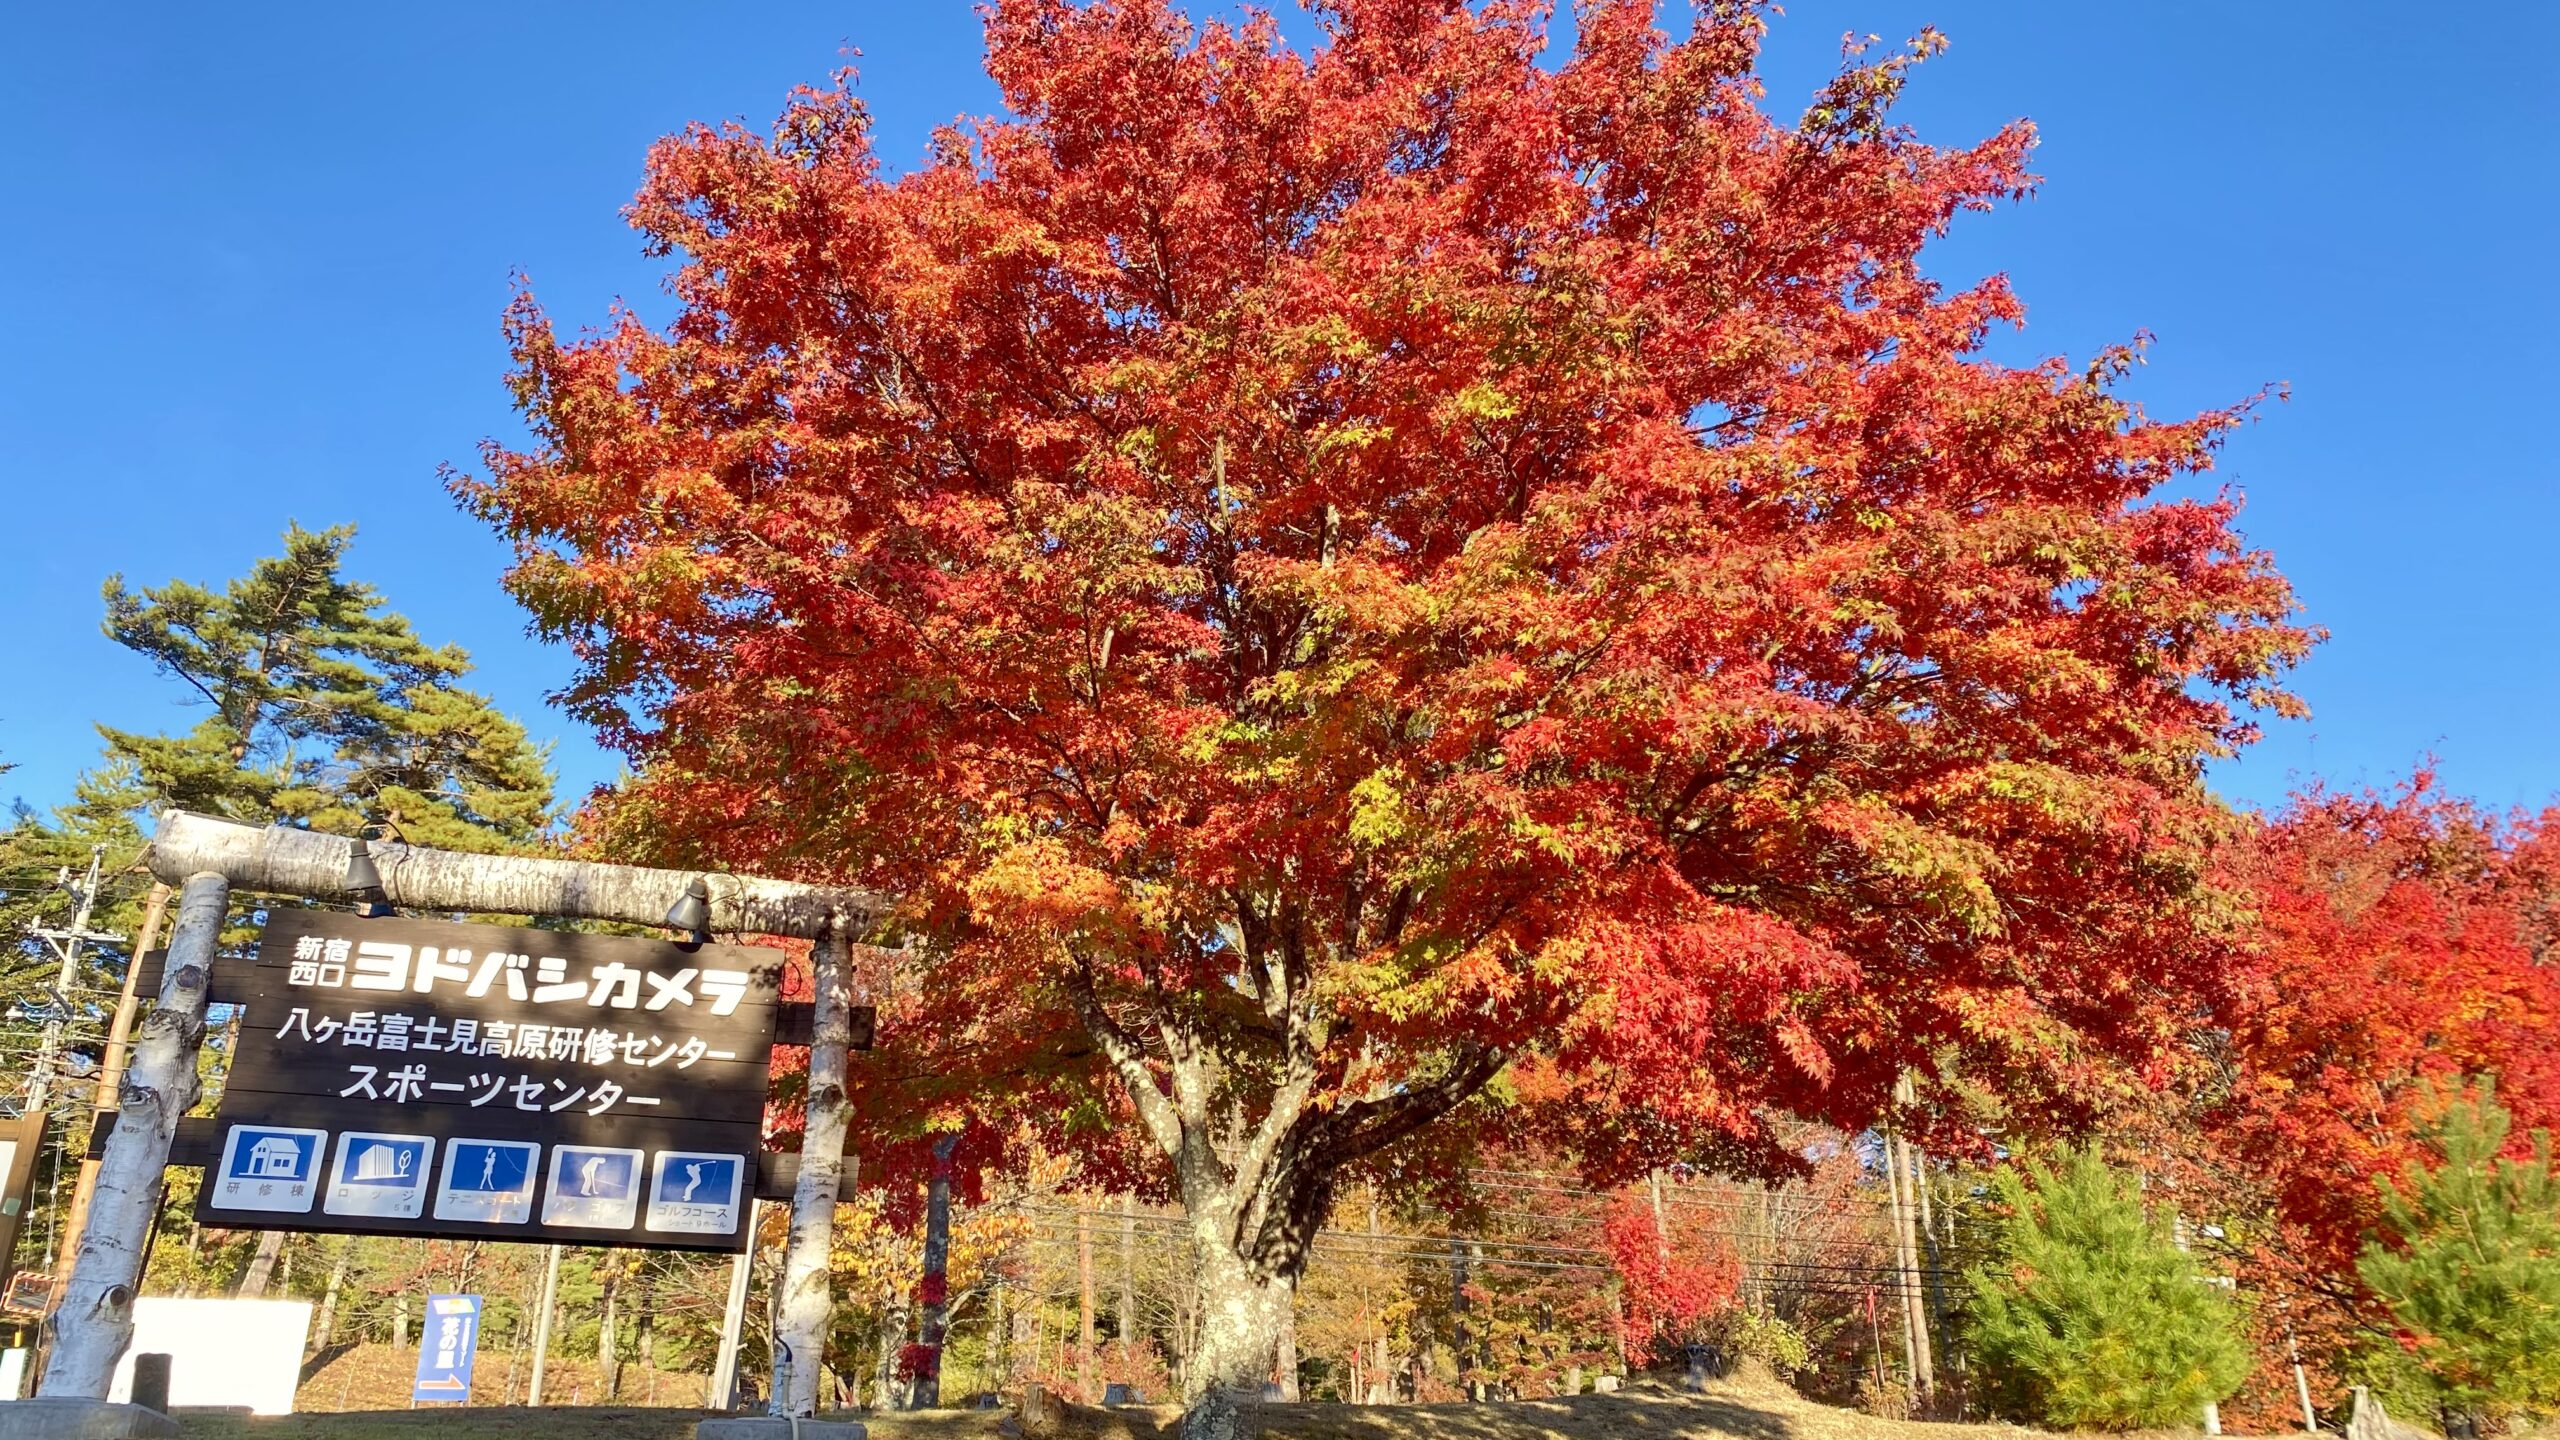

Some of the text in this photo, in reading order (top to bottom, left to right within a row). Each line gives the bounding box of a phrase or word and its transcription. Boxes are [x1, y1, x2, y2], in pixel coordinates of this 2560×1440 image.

[294, 935, 352, 963] 新宿
[288, 960, 346, 988] 西口
[350, 941, 749, 1016] ヨドバシカメラ
[340, 1063, 661, 1117] スポーツセンター
[226, 1181, 305, 1197] 研修棟
[657, 1204, 728, 1218] ゴルフコース
